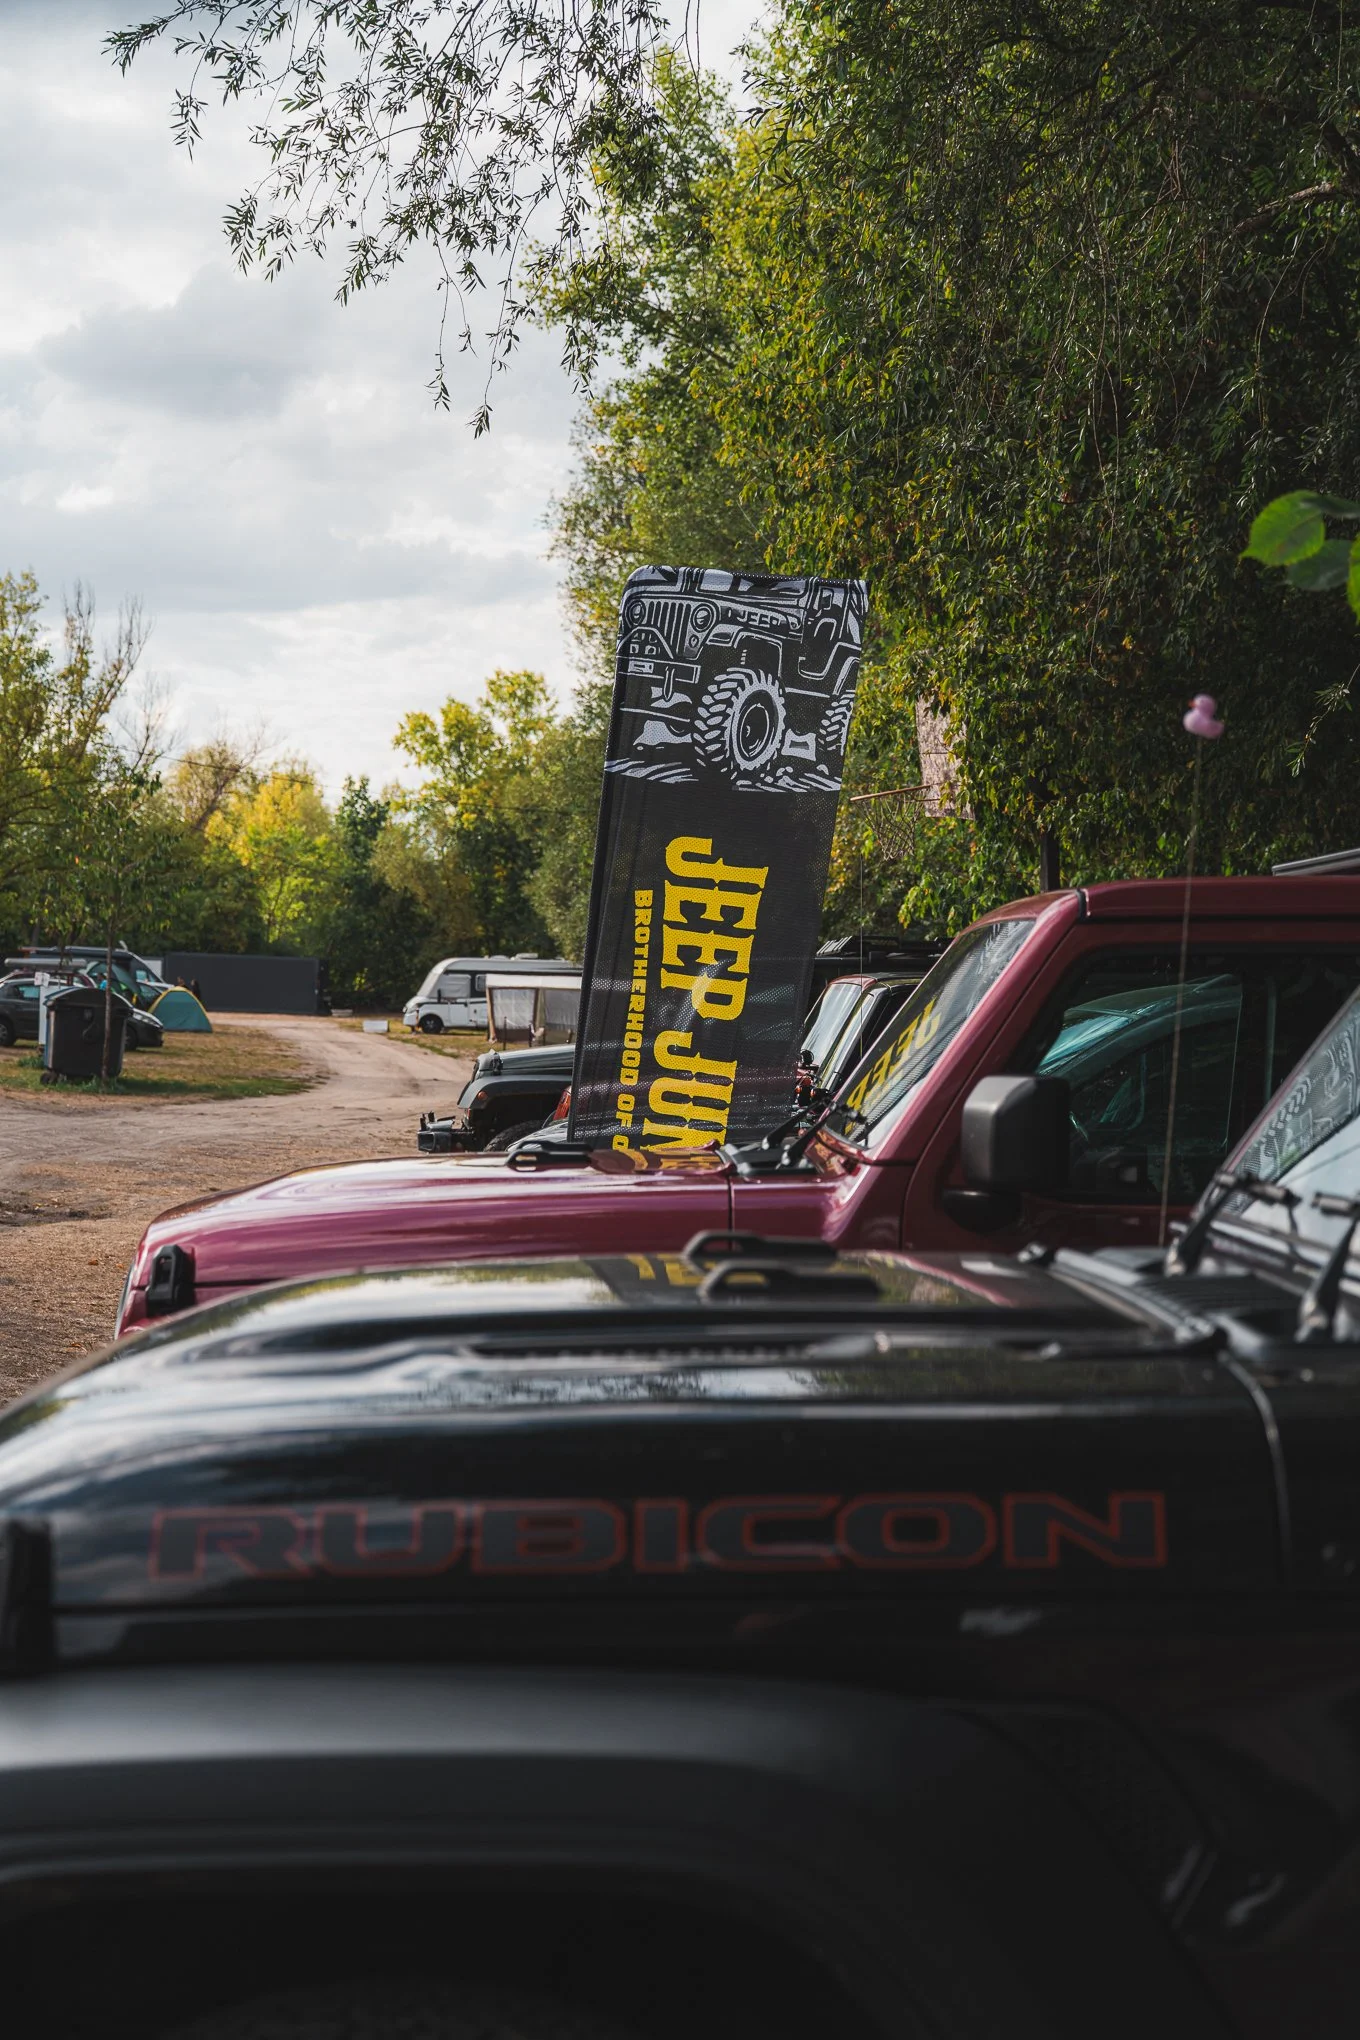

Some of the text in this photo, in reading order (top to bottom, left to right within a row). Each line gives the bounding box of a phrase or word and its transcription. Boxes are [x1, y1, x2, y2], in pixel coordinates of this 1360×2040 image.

[620, 889, 653, 1086] BROTHERHOOD
[660, 836, 769, 1021] JEEP
[616, 1093, 635, 1128] OF
[148, 1491, 1168, 1582] RUBICON
